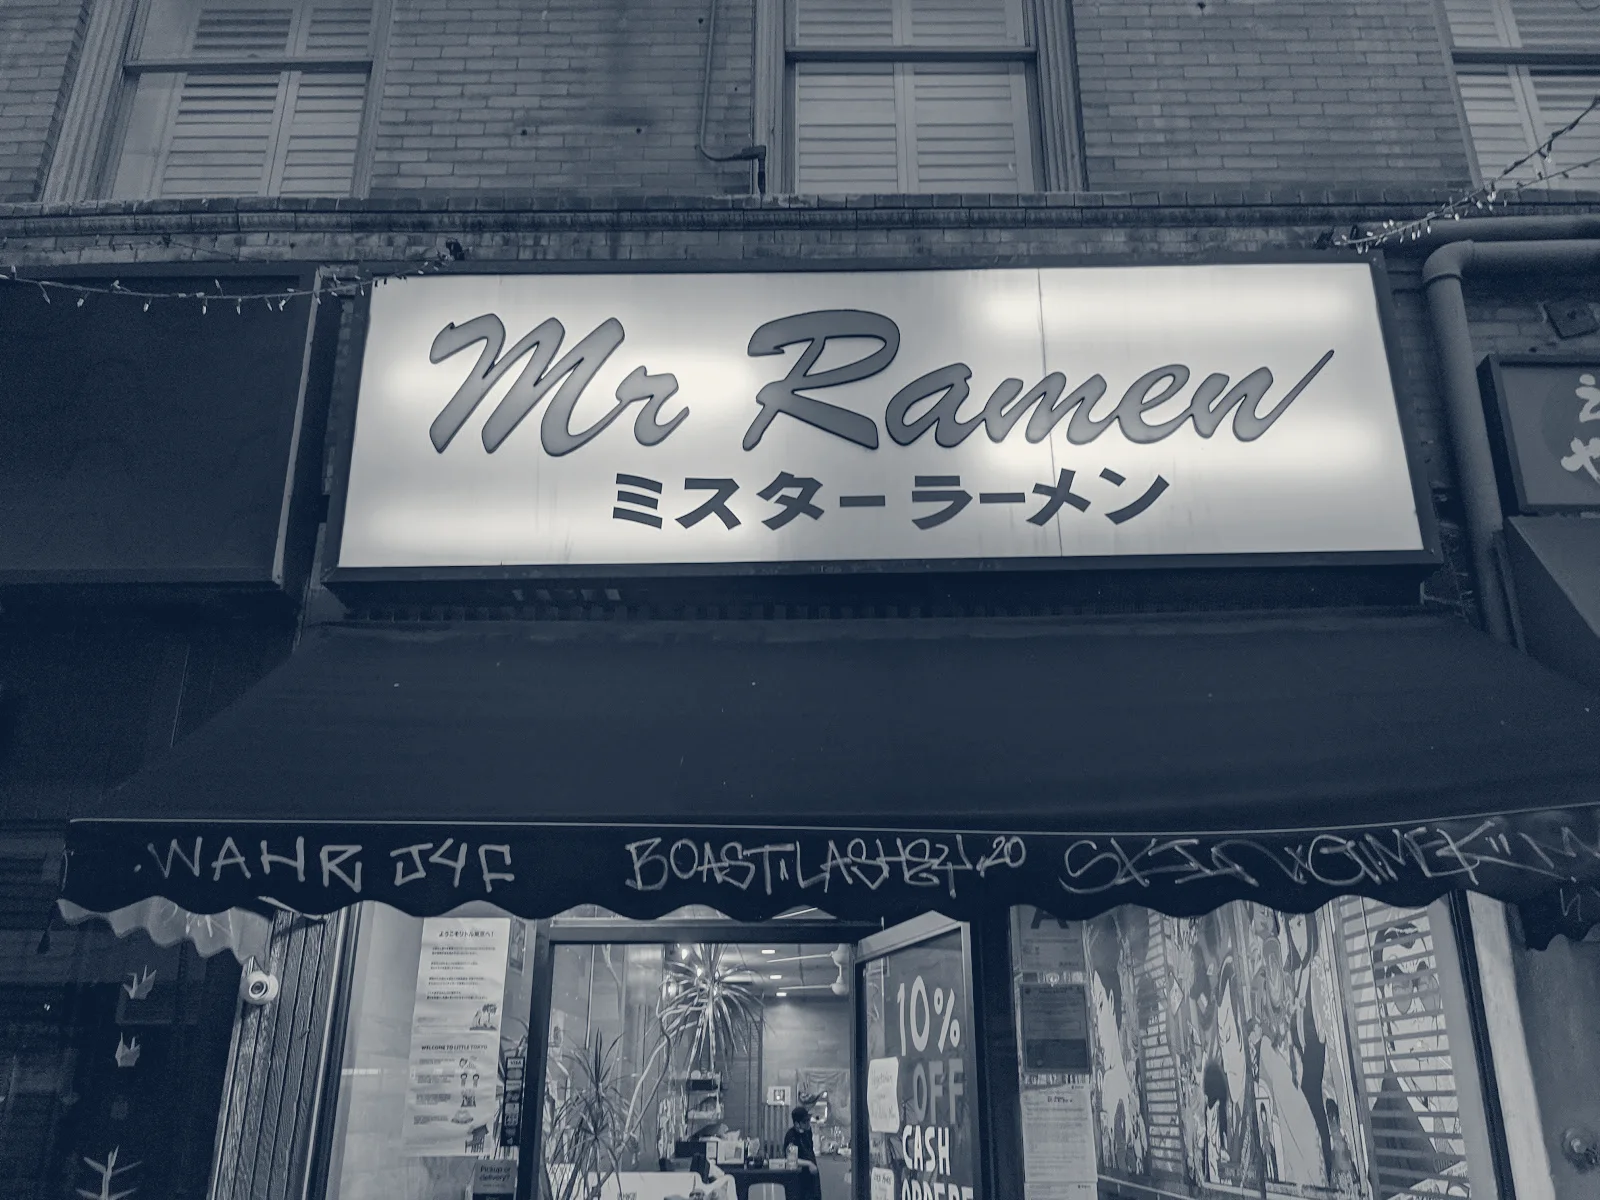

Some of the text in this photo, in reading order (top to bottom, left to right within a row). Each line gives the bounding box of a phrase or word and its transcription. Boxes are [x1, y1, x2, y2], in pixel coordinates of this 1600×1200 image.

[429, 308, 1335, 457] Mr Ramen
[612, 467, 1170, 531] ミスターラーメン
[897, 975, 961, 1056] 10%
[912, 1058, 964, 1125] OFF
[480, 1164, 503, 1174] Pickup
[902, 1124, 951, 1177] CASH
